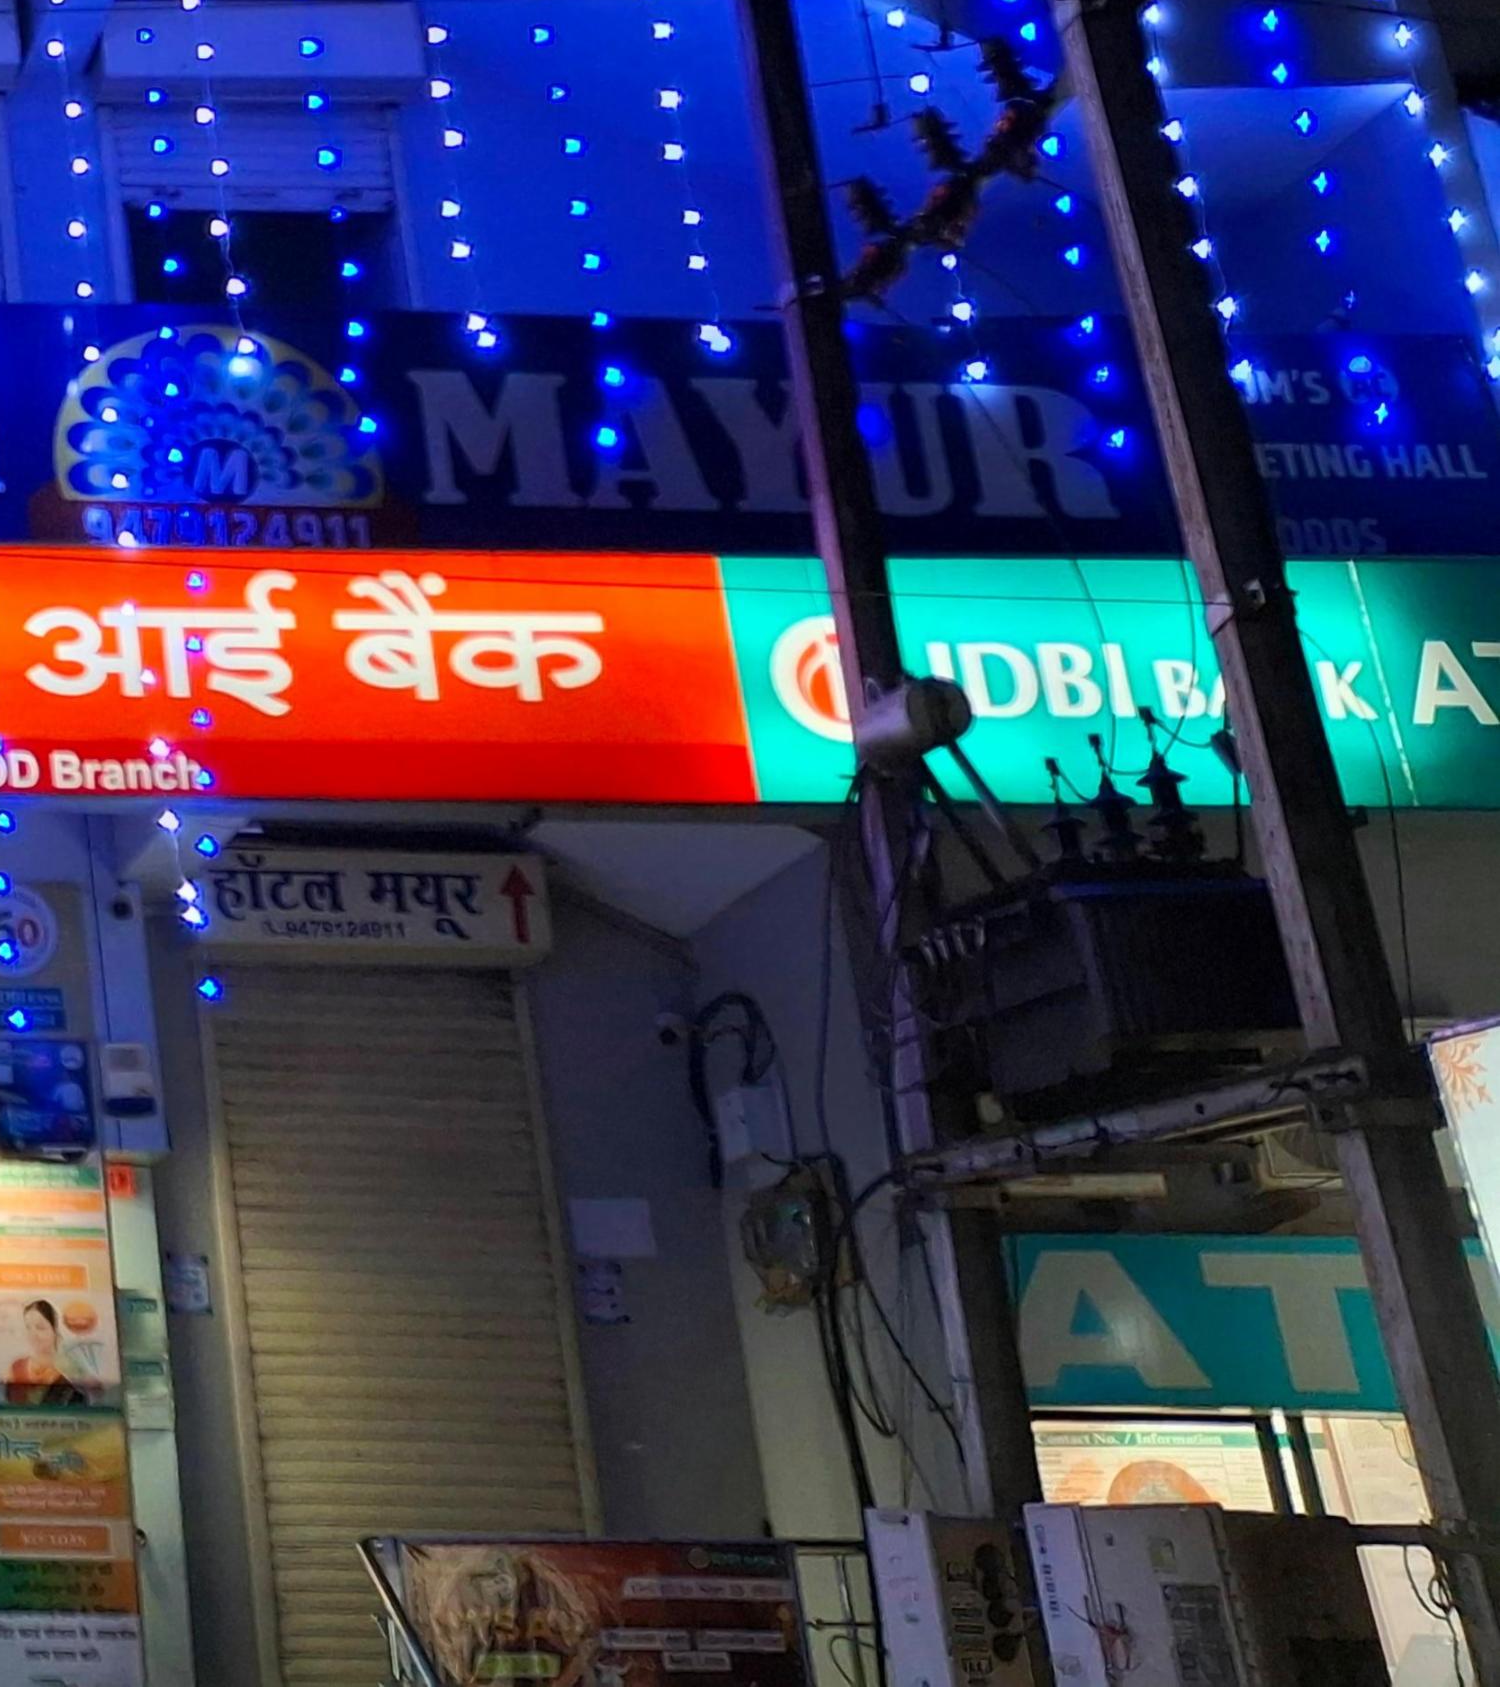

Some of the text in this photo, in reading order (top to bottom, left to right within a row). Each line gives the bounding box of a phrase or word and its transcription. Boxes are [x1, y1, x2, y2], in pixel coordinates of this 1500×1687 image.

[404, 369, 1122, 520] MAYUR
[1381, 443, 1489, 480] HALL
[24, 571, 297, 717] आई
[334, 571, 604, 703] बैंक
[925, 642, 1379, 721] IDBI BK
[50, 751, 203, 792] Branch
[366, 871, 482, 940] मयूर
[1035, 1431, 1091, 1445] Contact
[1134, 1433, 1223, 1446] Information
